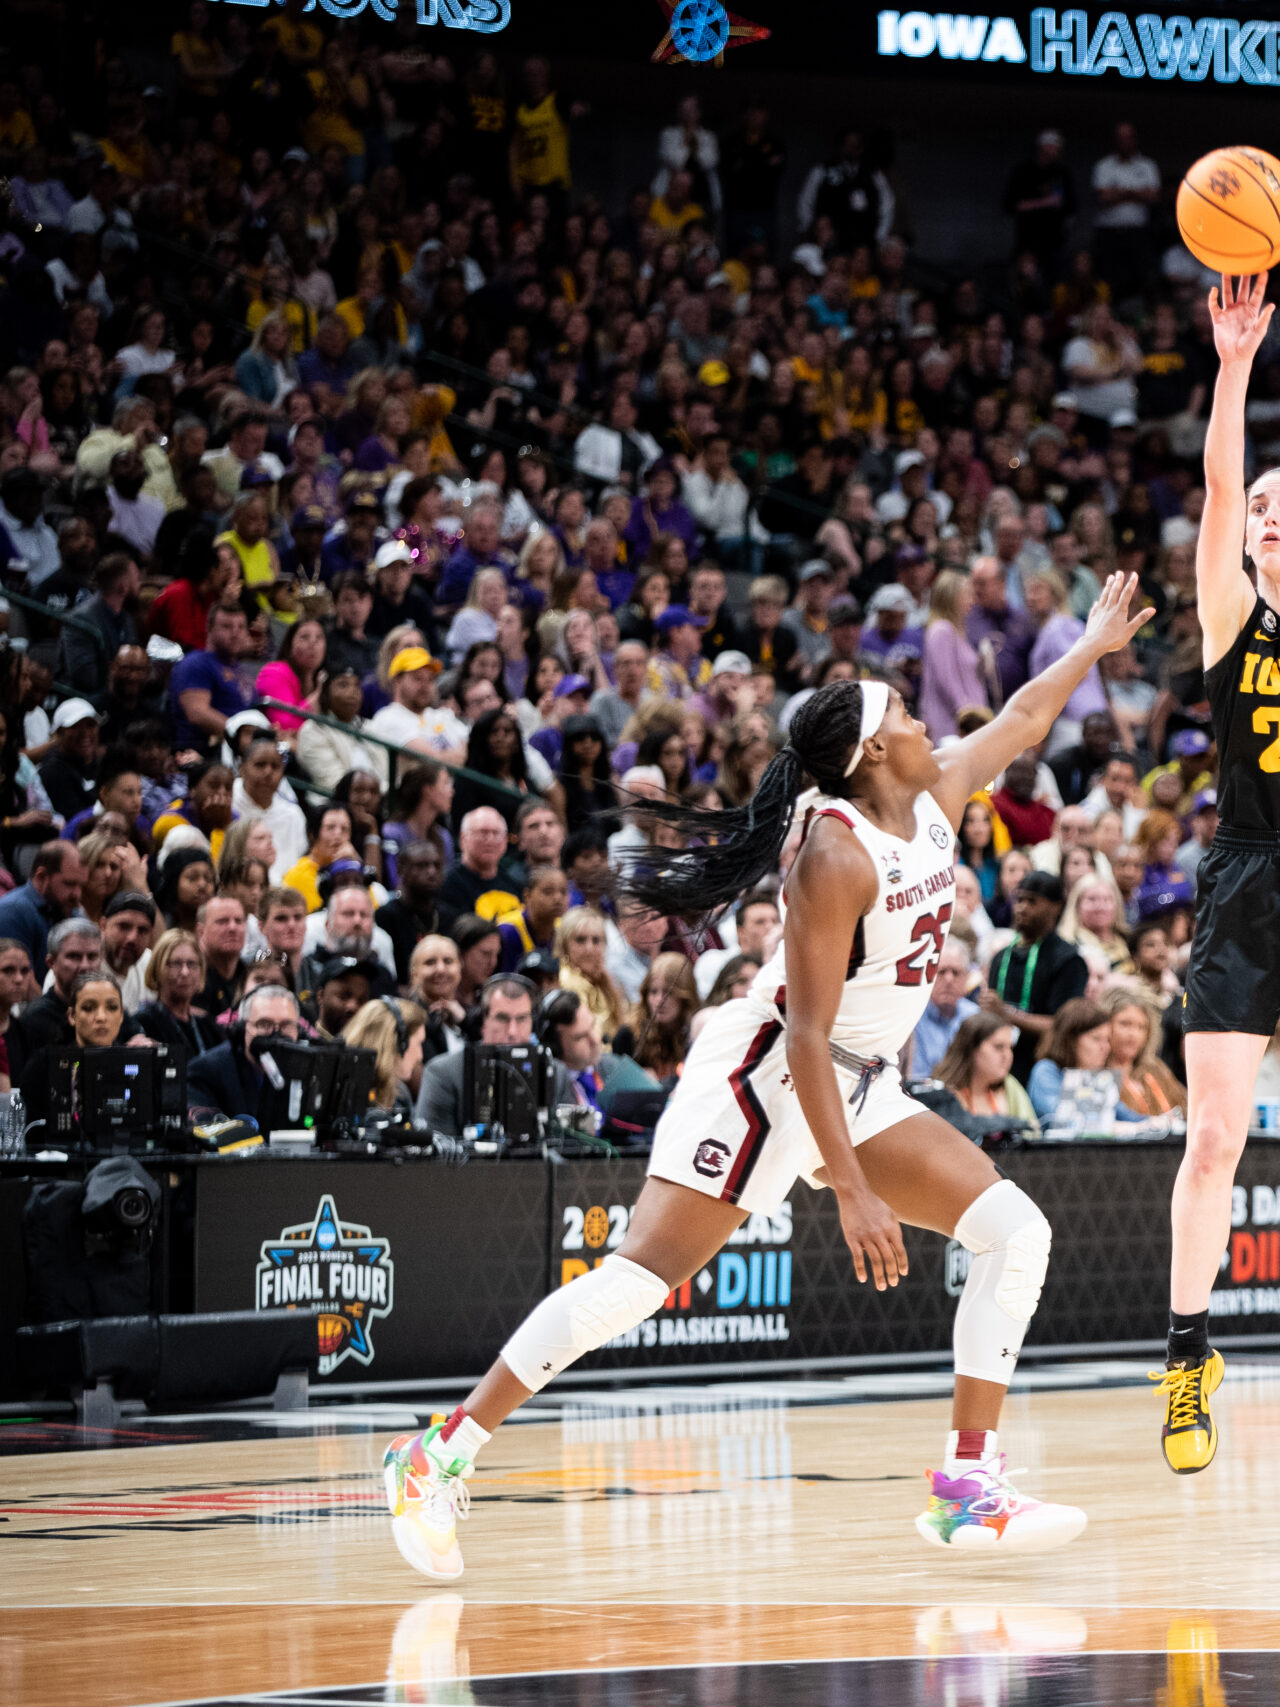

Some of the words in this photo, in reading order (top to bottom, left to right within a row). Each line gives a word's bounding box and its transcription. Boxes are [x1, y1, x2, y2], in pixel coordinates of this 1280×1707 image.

[878, 9, 1026, 63] IOWA
[886, 882, 926, 913] SOUTH
[561, 1204, 635, 1250] 202
[717, 1250, 792, 1308] DIII
[1231, 1230, 1280, 1283] DII
[261, 1264, 324, 1308] FINAL
[329, 1263, 388, 1305] FOUR
[659, 1313, 790, 1346] BASKETBALL
